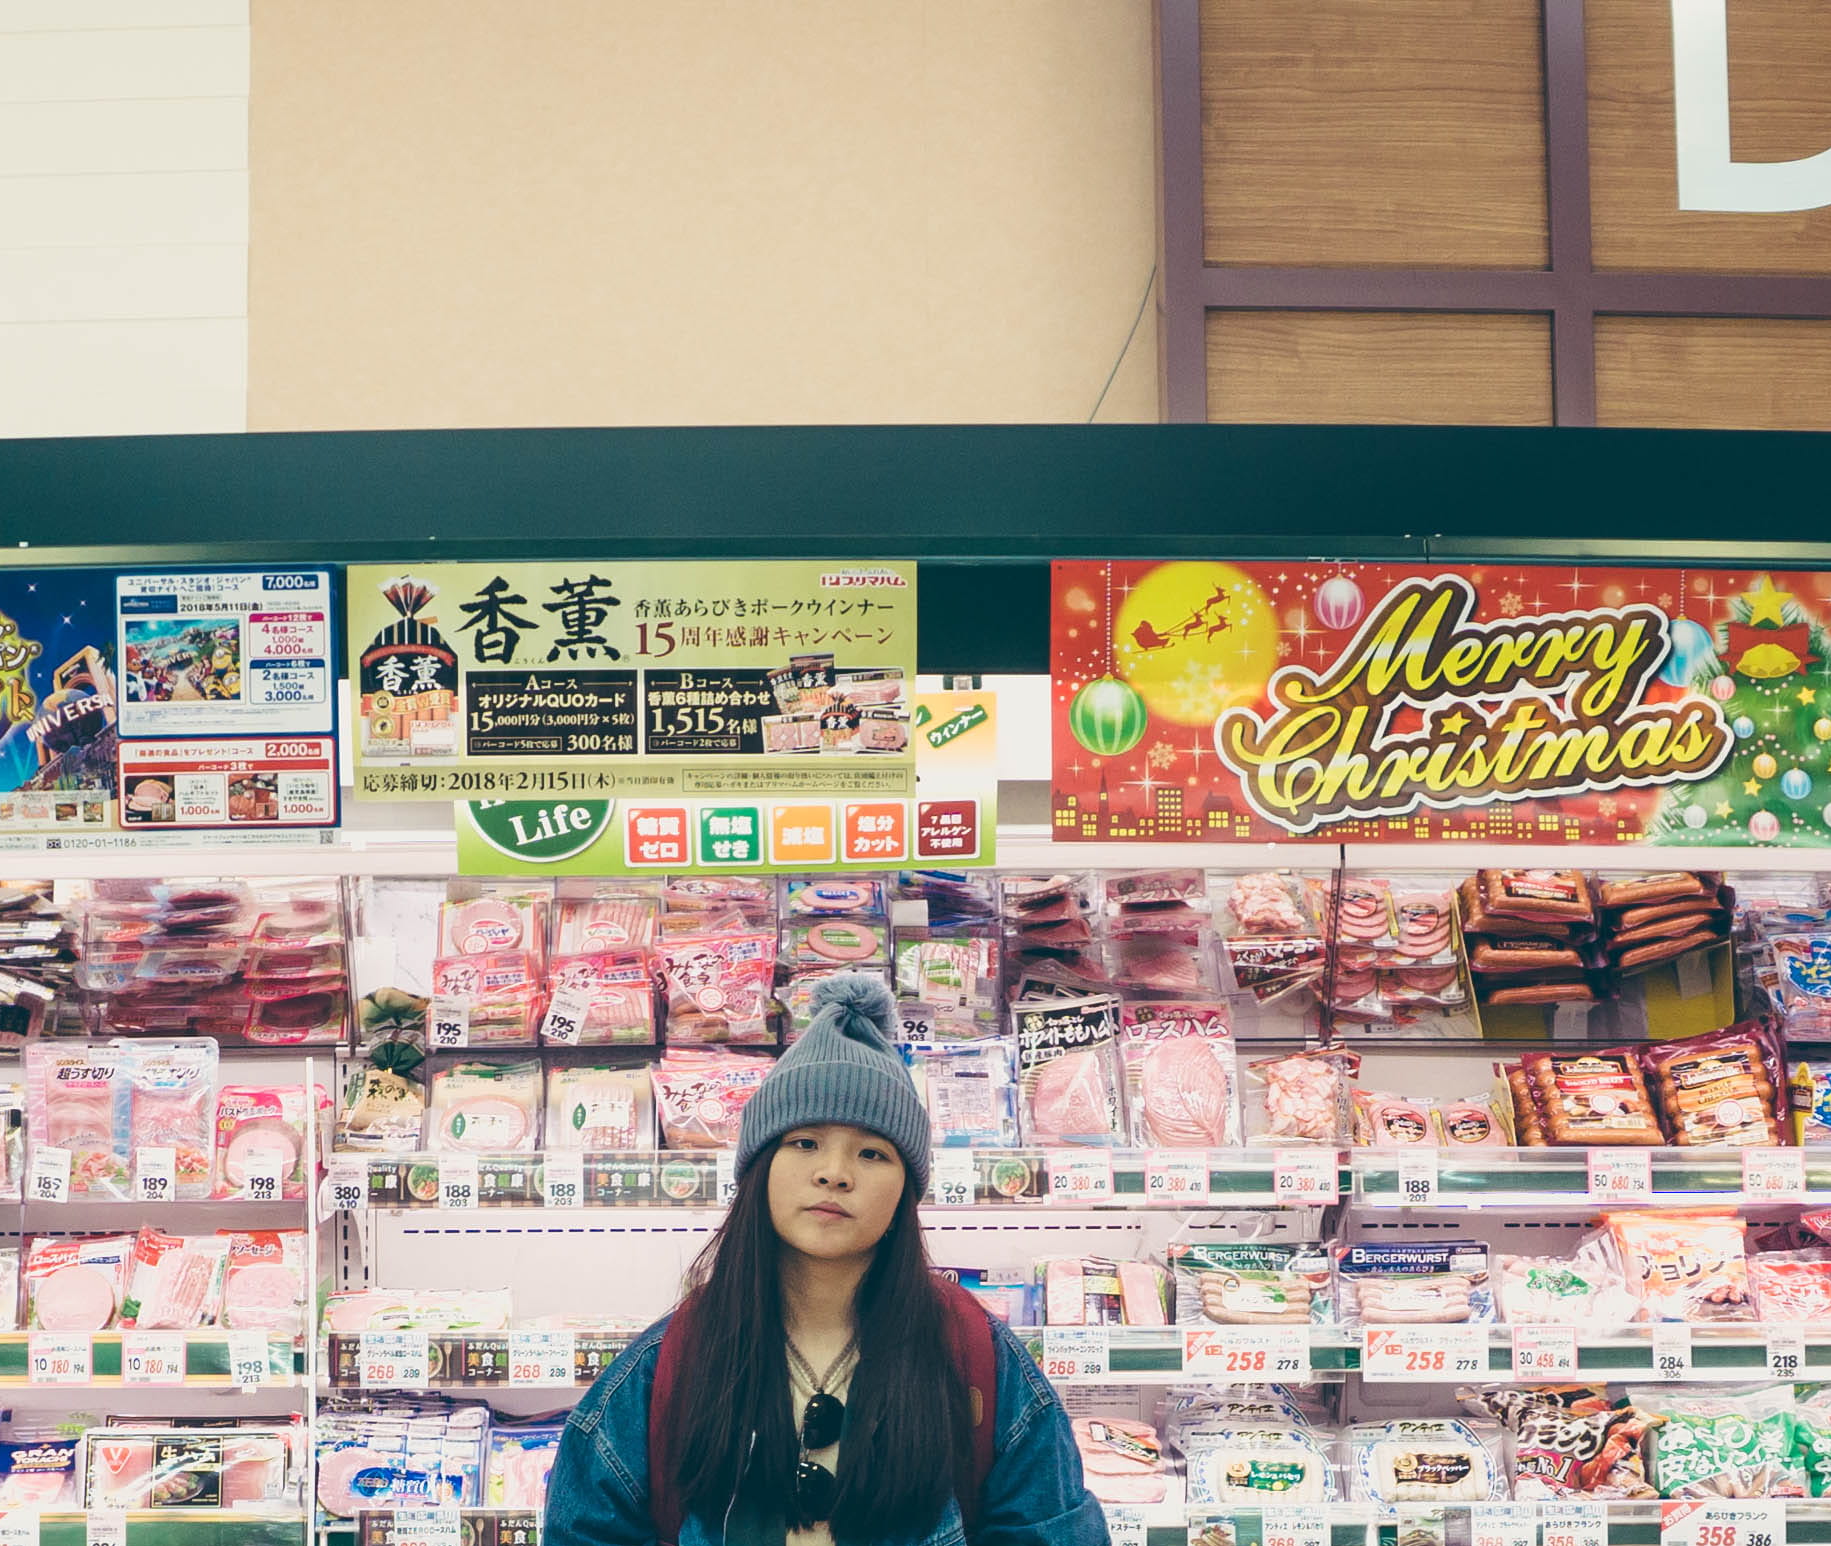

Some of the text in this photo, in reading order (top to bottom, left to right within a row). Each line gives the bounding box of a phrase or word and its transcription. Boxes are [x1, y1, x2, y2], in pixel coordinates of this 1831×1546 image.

[455, 574, 622, 665] 香薫
[635, 621, 895, 659] 15周年感謝キャンペーン
[1287, 578, 1648, 717] Merry
[524, 674, 578, 691] Aコース
[679, 674, 735, 691] Bコース
[477, 692, 626, 709] オリジナルQUOカード
[650, 707, 759, 738] 1,515名様
[567, 733, 635, 752] 300名様
[1231, 702, 1711, 816] Christmas
[512, 802, 592, 848] Life
[708, 815, 753, 837] 無塩
[856, 814, 895, 834] 塩分
[63, 837, 137, 849] 0120-01-1186
[639, 839, 679, 859] ゼロ
[712, 839, 751, 859] せき
[854, 835, 899, 853] カット
[435, 1021, 463, 1037] 195
[549, 1011, 576, 1035] 195
[248, 1176, 274, 1191] 198
[444, 1183, 471, 1198] 188
[940, 1181, 967, 1196] 96
[1351, 1246, 1449, 1265] BERGERWURST
[33, 1357, 48, 1371] 10
[1406, 1350, 1479, 1371] 258 278
[1771, 1354, 1798, 1369] 218
[368, 1365, 394, 1379] 268
[1705, 1510, 1768, 1521] あらびきフランク
